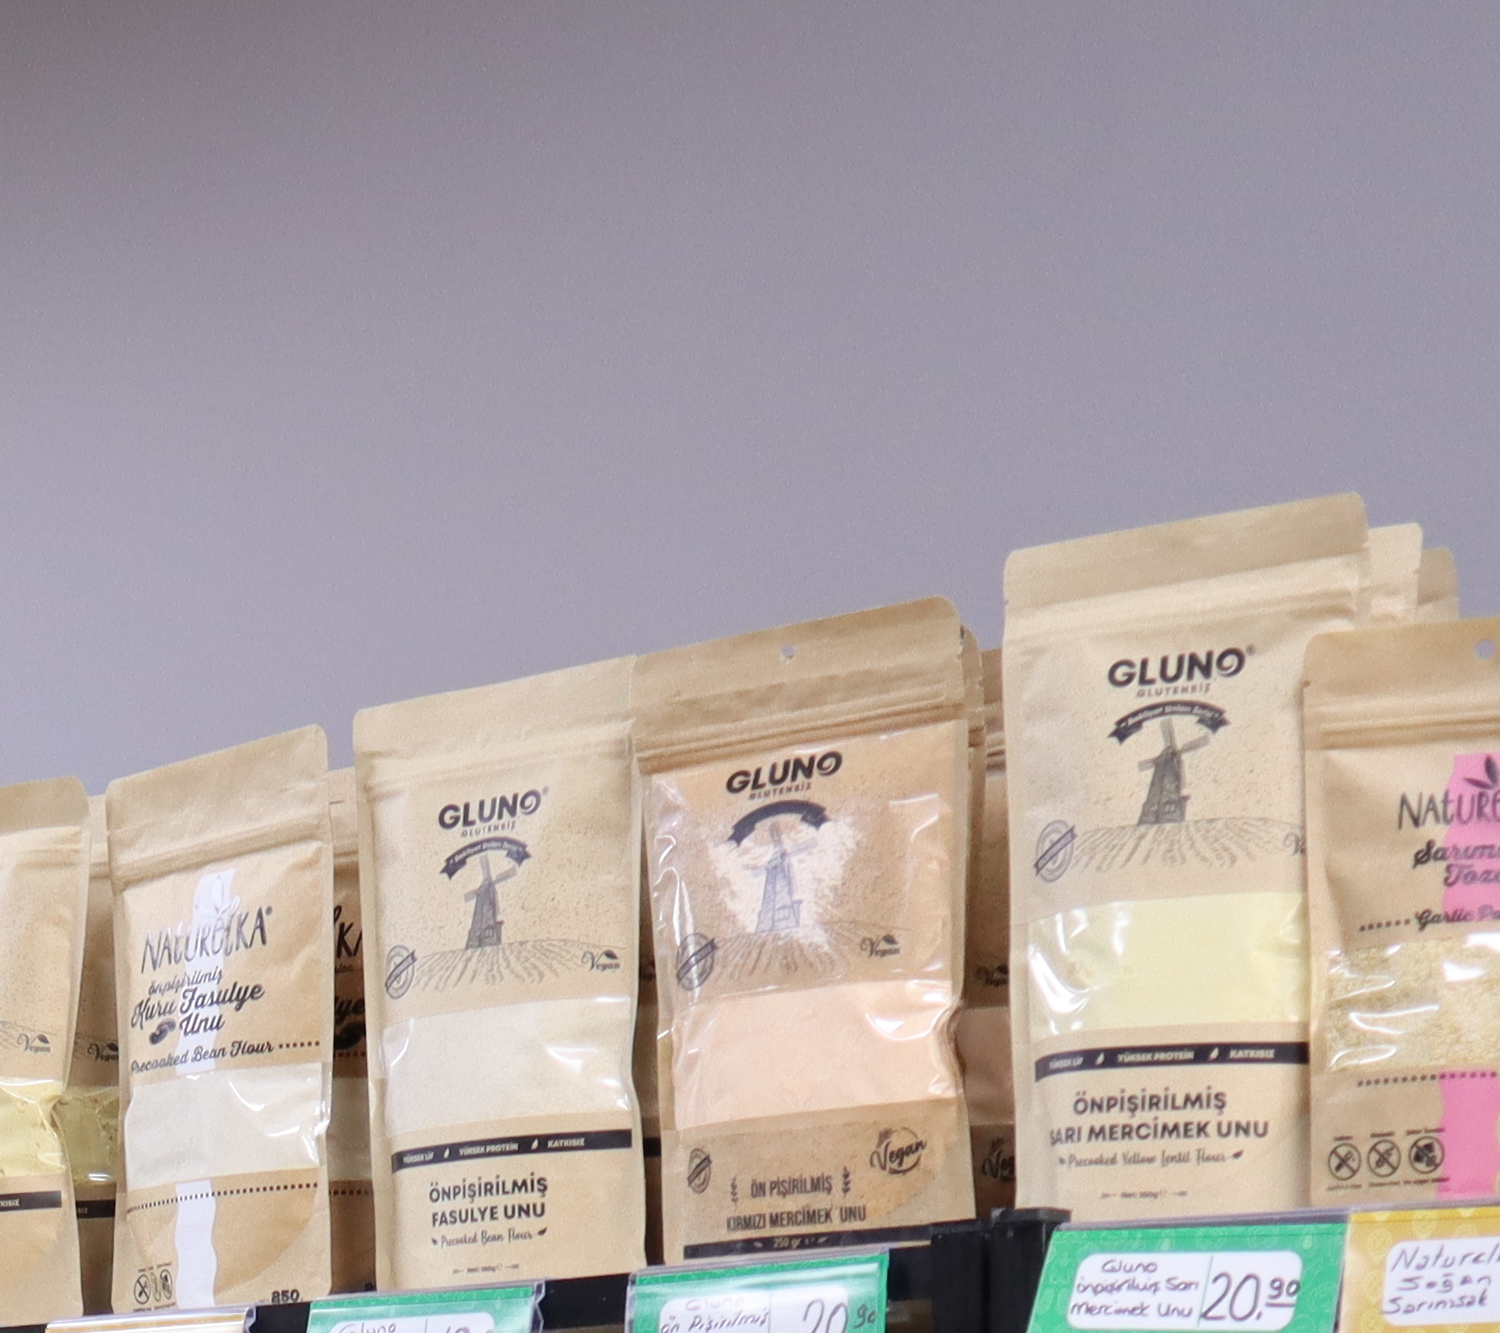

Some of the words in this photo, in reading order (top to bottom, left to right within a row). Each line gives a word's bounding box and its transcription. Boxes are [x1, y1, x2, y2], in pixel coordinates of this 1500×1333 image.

[1106, 647, 1246, 691] GLUNO
[725, 750, 843, 797] GLUNO
[438, 788, 540, 831] GLUNO
[131, 997, 177, 1030] Kuru
[180, 1013, 225, 1036] Unu
[191, 1045, 226, 1064] Bean
[1073, 1085, 1227, 1118] ÖNPİŞİRİLMİŞ
[1087, 1116, 1210, 1142] MERCİMEK
[1217, 1120, 1269, 1139] UNU
[869, 1137, 927, 1170] Vegan
[429, 1171, 548, 1204] ÖNPİŞİRİLMİŞ
[751, 1178, 767, 1198] ÖN
[432, 1204, 499, 1228] FASULYE
[503, 1201, 546, 1220] UNU
[726, 1213, 767, 1232] KIRMIZI
[769, 1206, 832, 1228] MERCİMEK
[840, 1205, 866, 1223] UNU
[1102, 1259, 1157, 1274] Gluno
[1157, 1305, 1193, 1318] Unu
